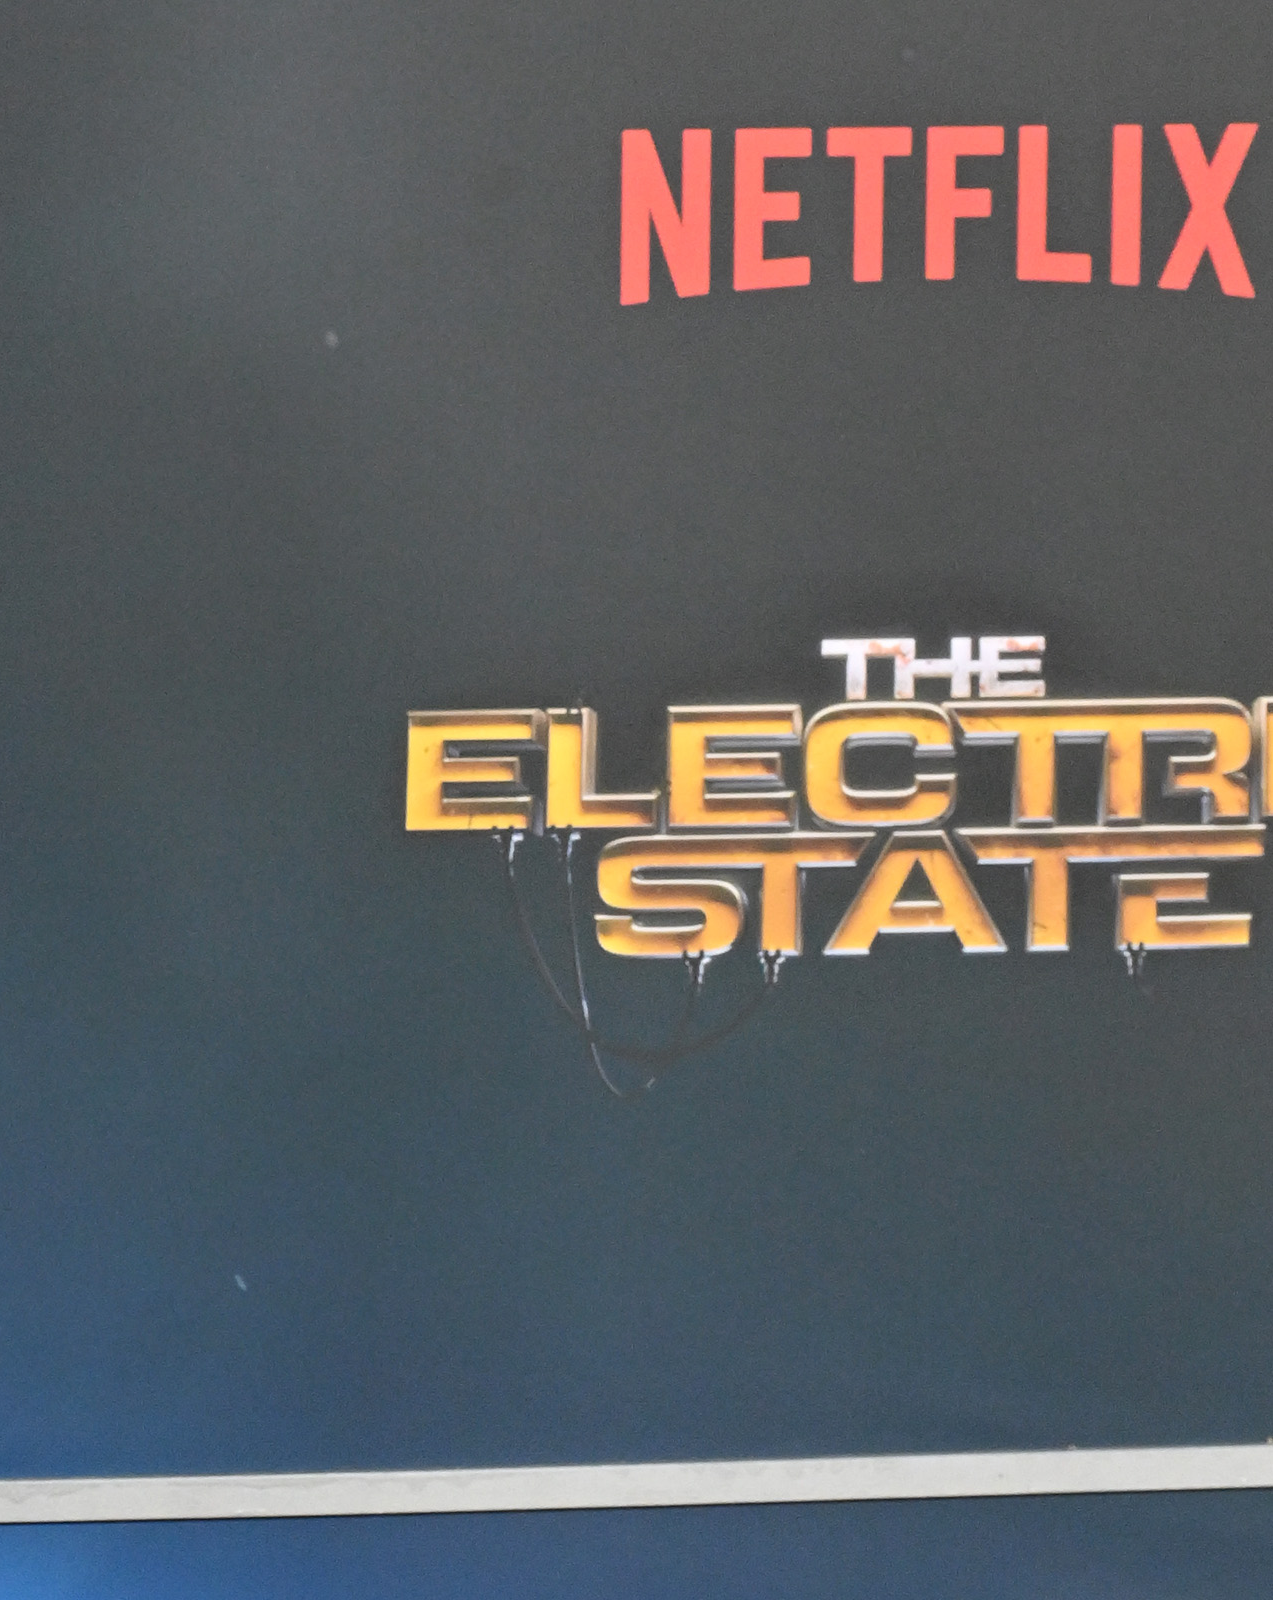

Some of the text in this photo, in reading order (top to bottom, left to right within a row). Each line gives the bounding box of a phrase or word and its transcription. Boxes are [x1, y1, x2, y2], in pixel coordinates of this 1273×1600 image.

[619, 122, 1258, 306] NETFLIX
[820, 635, 1046, 699] THE
[594, 824, 1267, 959] STATE
